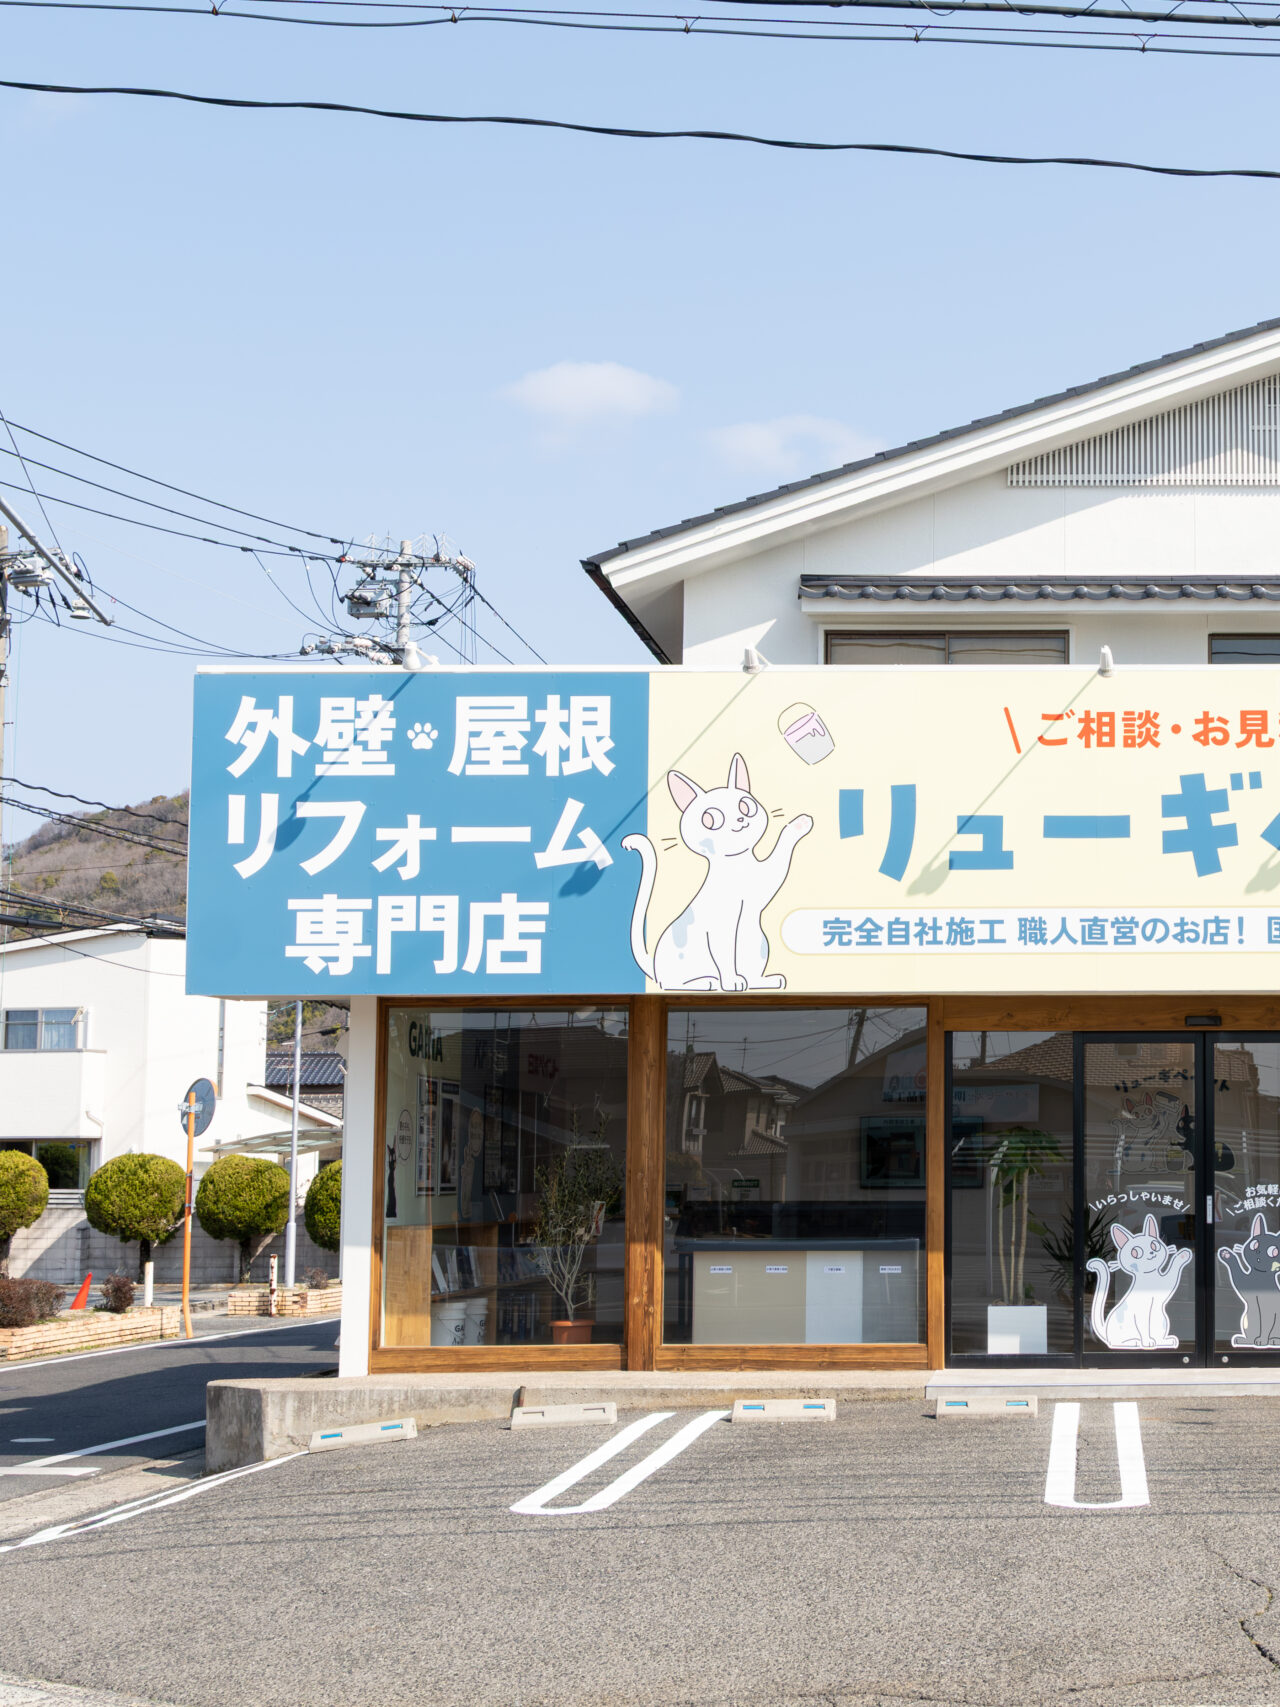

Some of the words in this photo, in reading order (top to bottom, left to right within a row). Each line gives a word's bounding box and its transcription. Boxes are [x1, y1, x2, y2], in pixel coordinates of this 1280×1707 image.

[225, 695, 396, 778] 外壁
[448, 695, 615, 777] 屋根
[227, 793, 614, 880] リフォーム
[285, 893, 550, 976] 専門店
[822, 916, 1007, 946] 完全自社施工
[1017, 915, 1245, 946] 職人直営のお店！
[1096, 1190, 1184, 1210] いらっしゃいませ
